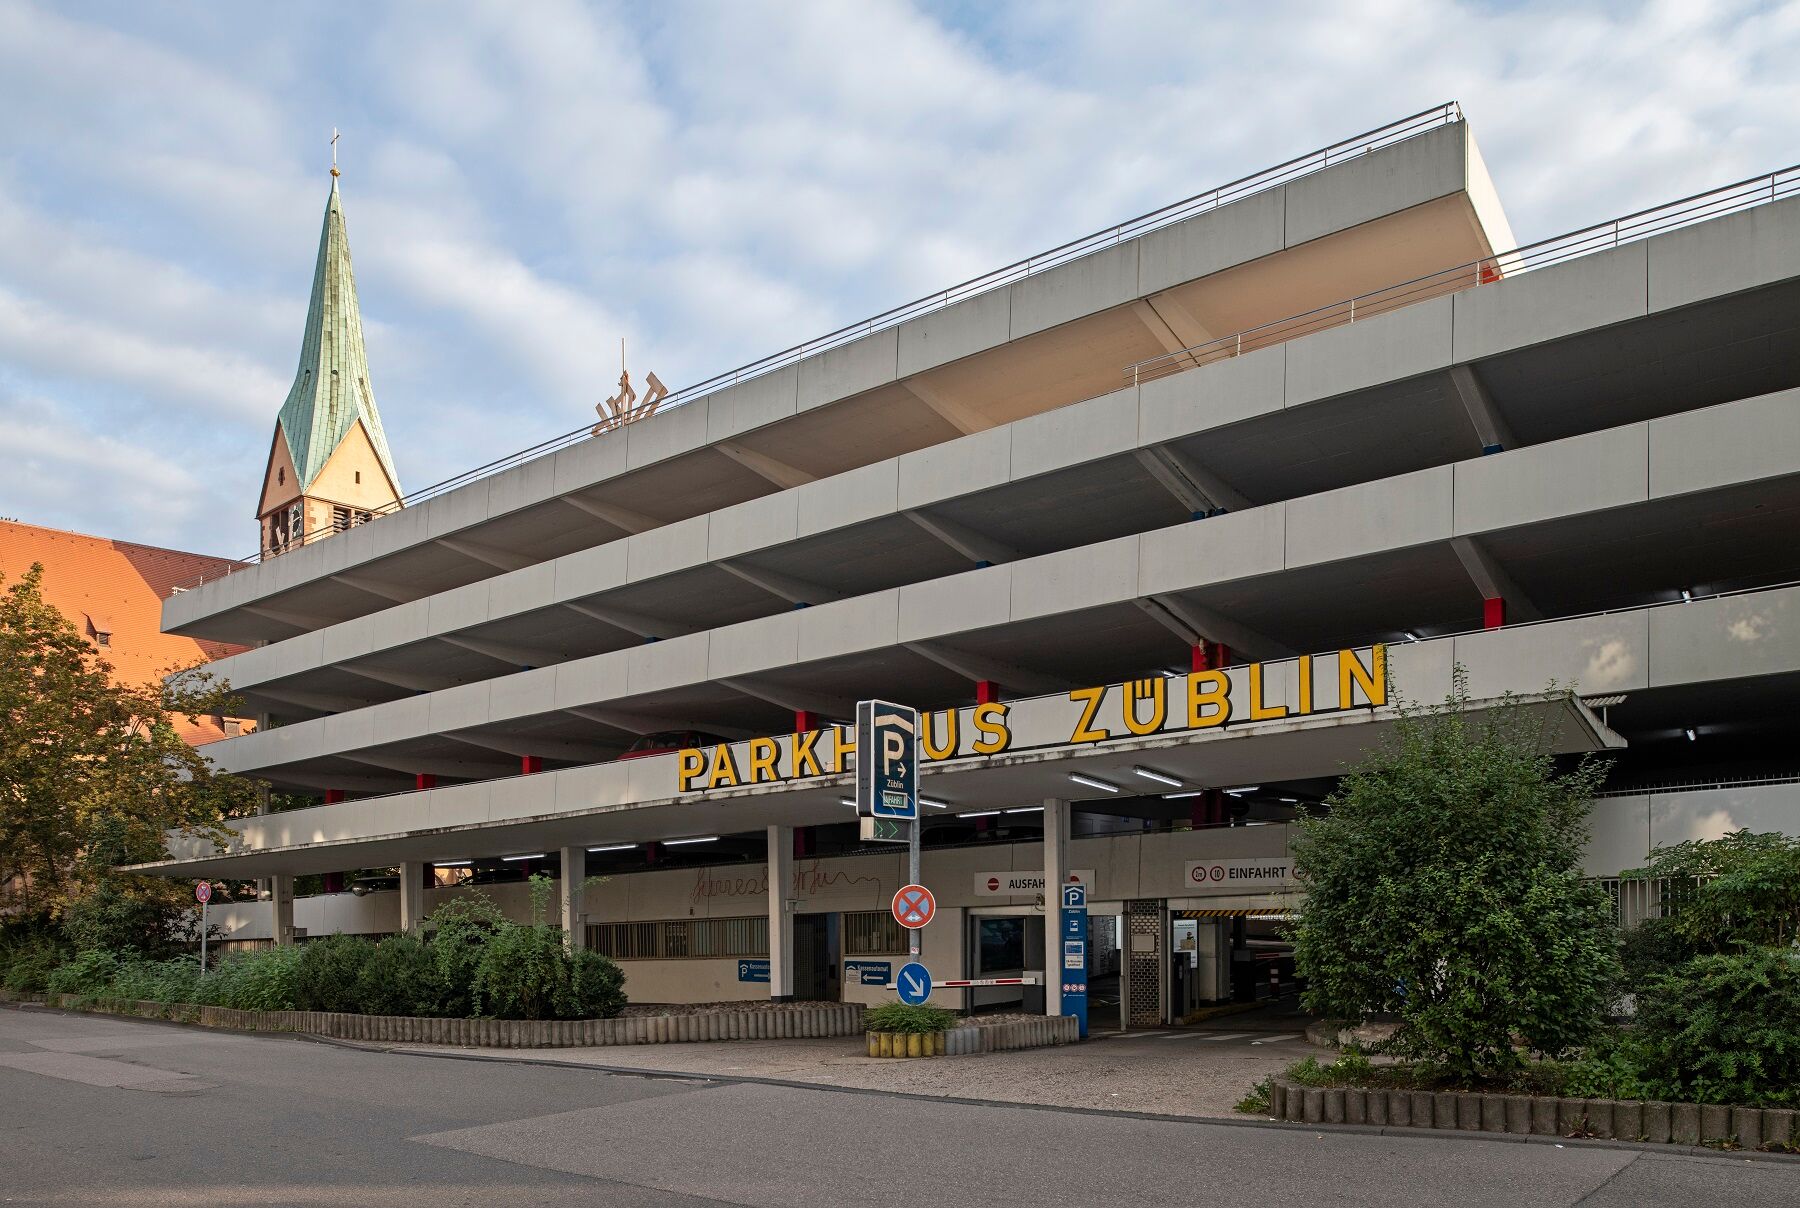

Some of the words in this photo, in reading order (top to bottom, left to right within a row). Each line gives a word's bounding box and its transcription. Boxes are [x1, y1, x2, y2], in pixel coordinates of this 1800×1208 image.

[678, 702, 1012, 792] PARKHUS
[1069, 643, 1389, 744] ZÜBLIN
[883, 730, 905, 776] P
[886, 779, 904, 789] Züblin
[1229, 867, 1287, 879] EINFAHRT
[1009, 879, 1045, 889] AUSFAH
[1069, 892, 1079, 905] P
[741, 967, 748, 978] P
